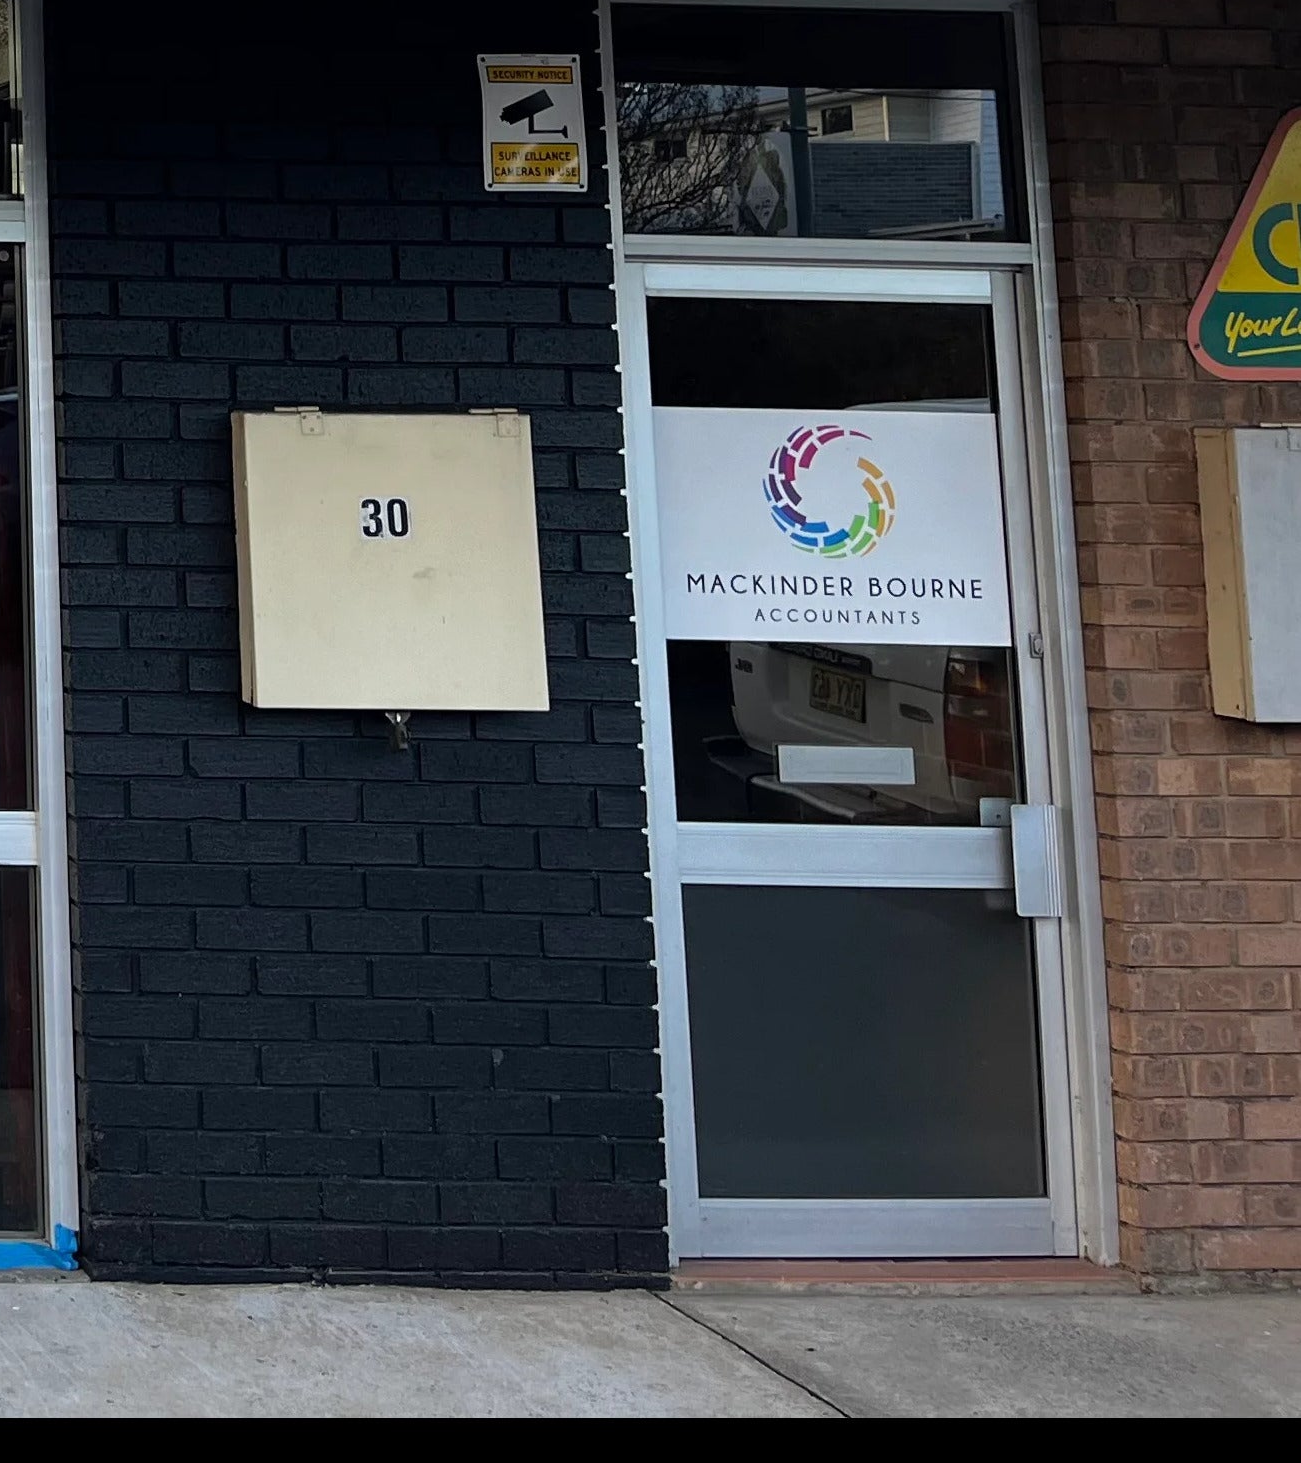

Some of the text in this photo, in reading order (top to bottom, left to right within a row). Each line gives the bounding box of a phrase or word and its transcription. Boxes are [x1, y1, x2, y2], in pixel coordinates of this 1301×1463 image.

[492, 69, 568, 80] SECURITY NOTICE
[544, 166, 555, 176] IN
[1251, 201, 1301, 286] C
[1224, 310, 1280, 354] Your
[360, 497, 410, 538] 30
[686, 572, 984, 600] MACKINDER BOURNE
[754, 608, 921, 626] ACCOUNTANTS
